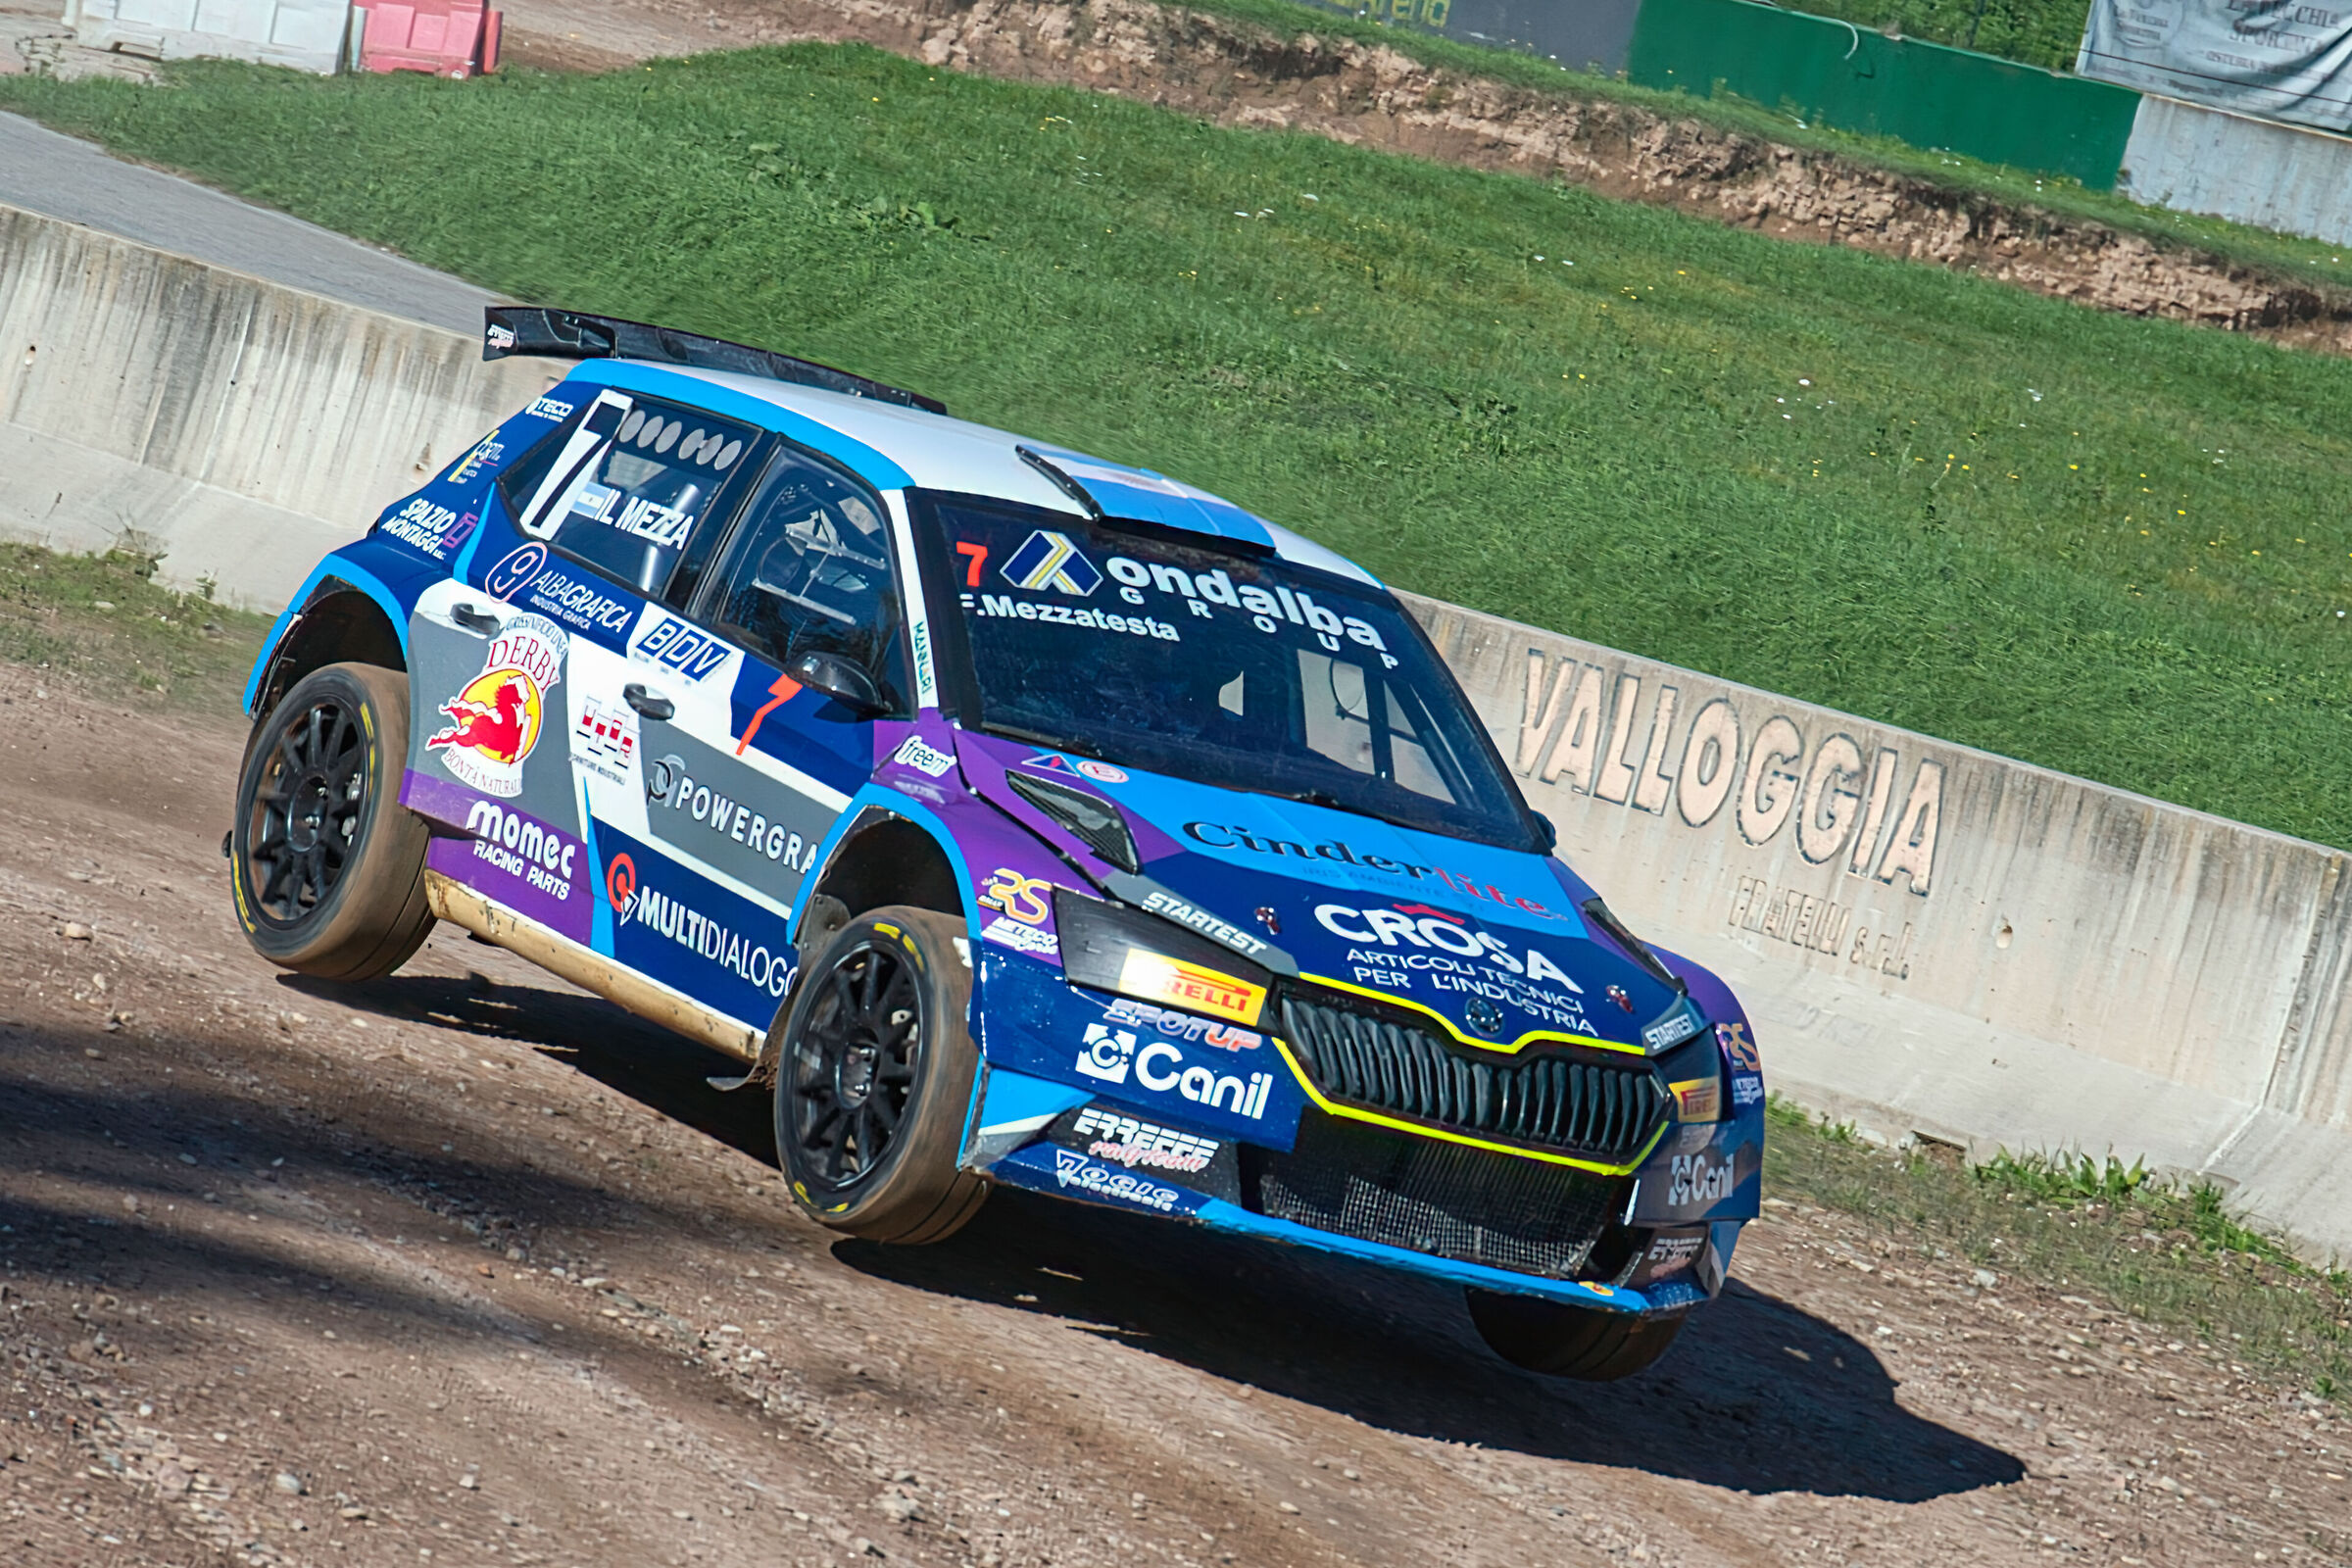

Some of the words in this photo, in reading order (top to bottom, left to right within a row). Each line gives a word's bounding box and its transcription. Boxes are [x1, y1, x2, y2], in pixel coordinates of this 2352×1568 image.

[380, 515, 444, 554] MONTAGGI
[399, 498, 457, 534] SPAZIO
[614, 496, 694, 551] MEZZA
[956, 541, 988, 587] 7
[530, 569, 633, 634] ALBAGRAFICA
[1105, 556, 1389, 652] ondalba
[487, 635, 561, 691] DERBY
[644, 622, 725, 673] BDV
[735, 674, 803, 756] 7
[899, 740, 951, 773] freem
[1516, 648, 1946, 897] VALLOGGIA
[473, 839, 525, 877] RACING
[526, 864, 570, 901] PARTS
[1182, 821, 1560, 919] Cinderlite
[1143, 892, 1267, 955] STARTEST
[1728, 875, 1851, 956] FRATELLI
[1314, 904, 1584, 994] CROSA
[1347, 948, 1476, 976] ARTICOLI
[1478, 966, 1584, 1013] TECNICI
[1160, 967, 1251, 1011] RELLI
[1353, 966, 1412, 989] PER
[1431, 973, 1598, 1037] L'INDUSTRIA
[1135, 1042, 1273, 1120] Canil
[1073, 1107, 1220, 1157] ERREFFE
